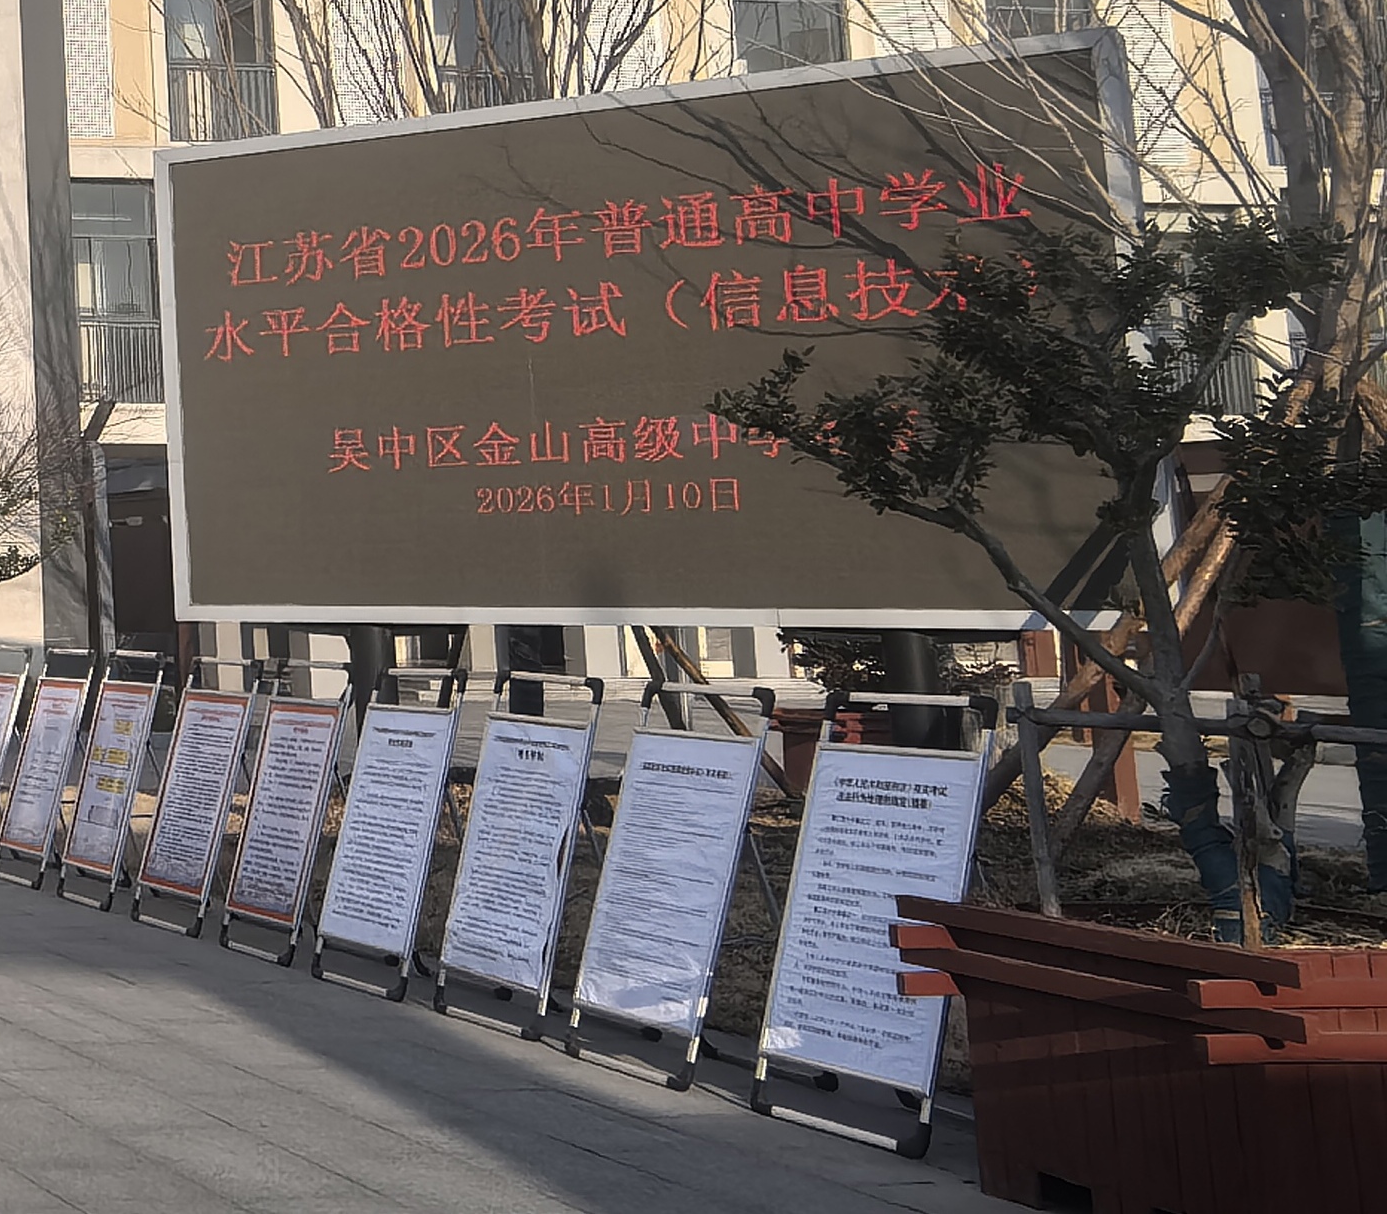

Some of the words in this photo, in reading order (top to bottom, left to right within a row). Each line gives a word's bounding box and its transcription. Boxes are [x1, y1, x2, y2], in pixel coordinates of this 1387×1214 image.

[226, 161, 1032, 287] 江苏省2026年普通高中学业
[327, 403, 920, 473] 吴中区金山高级中学
[475, 478, 740, 516] 2026年1月10日
